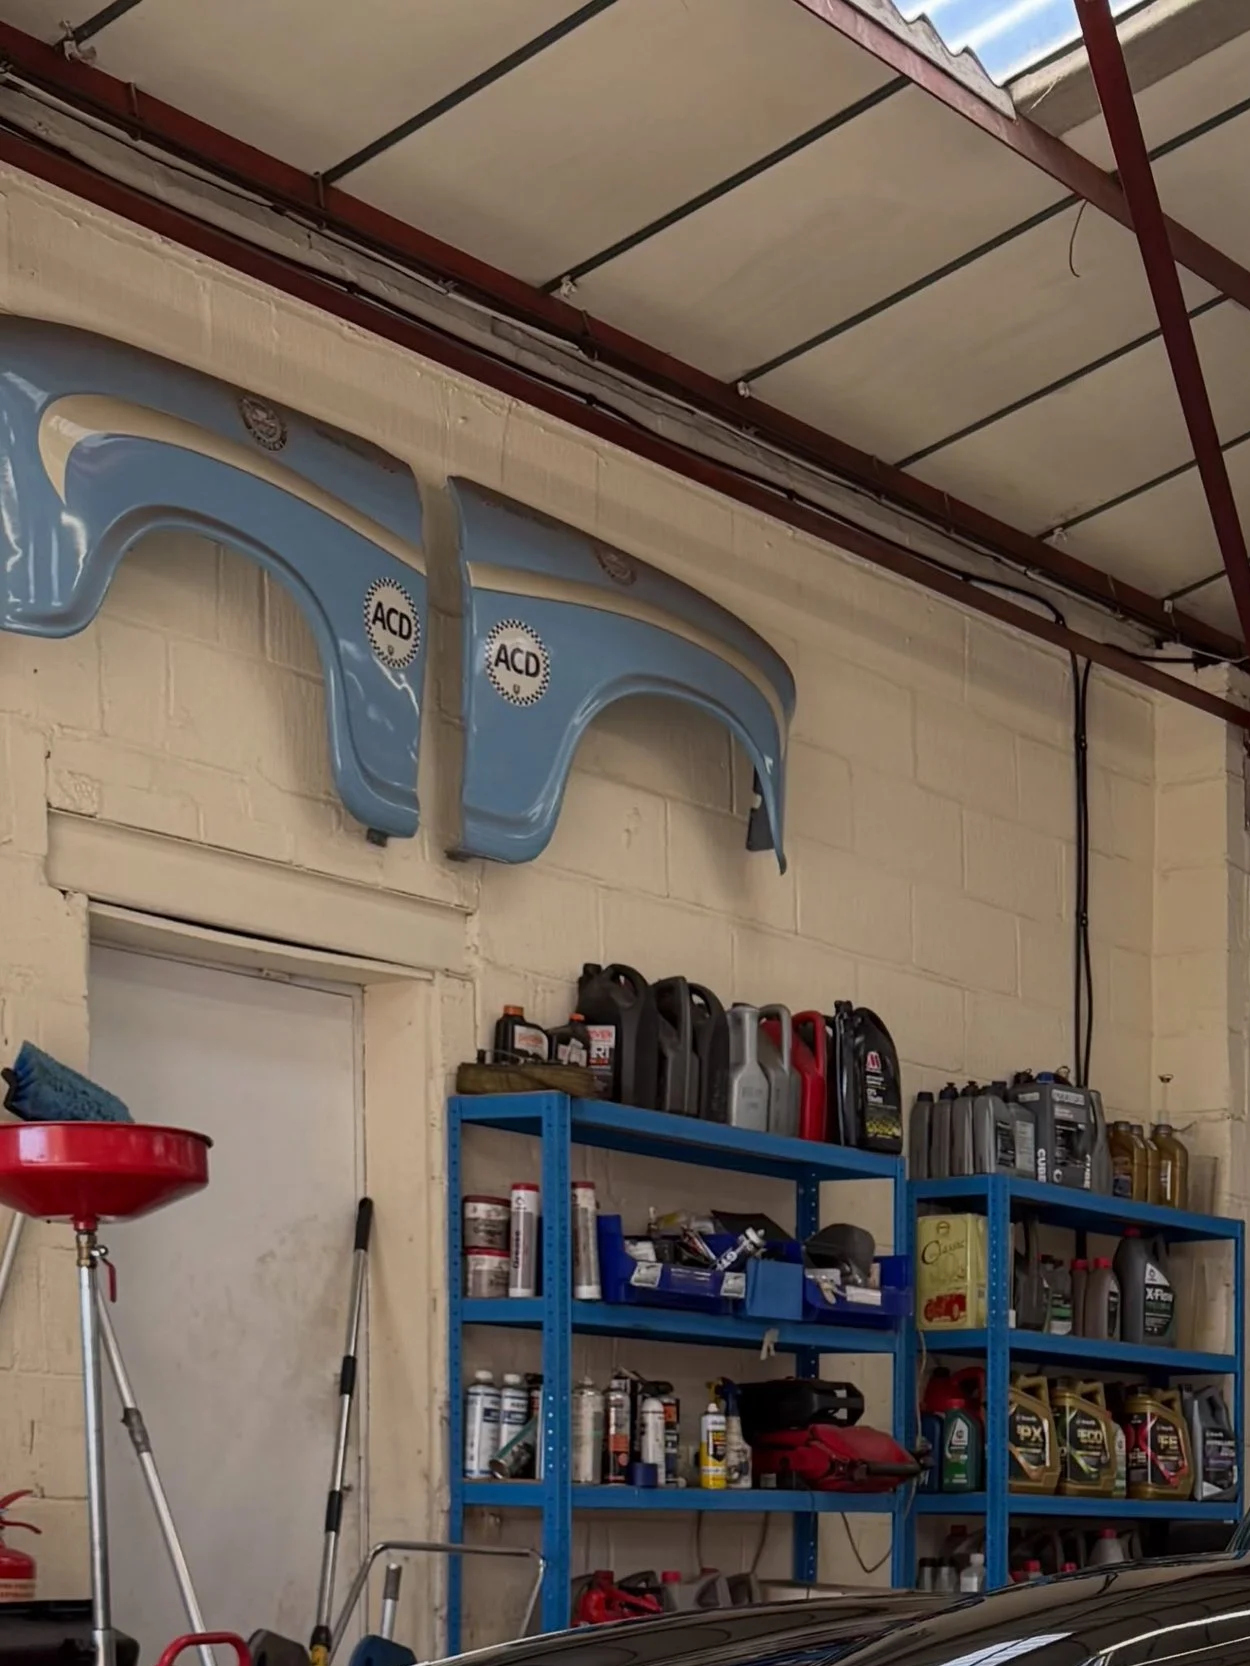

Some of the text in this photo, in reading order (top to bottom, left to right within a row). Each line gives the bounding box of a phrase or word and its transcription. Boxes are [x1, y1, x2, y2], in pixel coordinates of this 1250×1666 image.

[372, 601, 412, 641] ACD
[494, 644, 541, 678] ACD
[1037, 1148, 1047, 1184] CUBE
